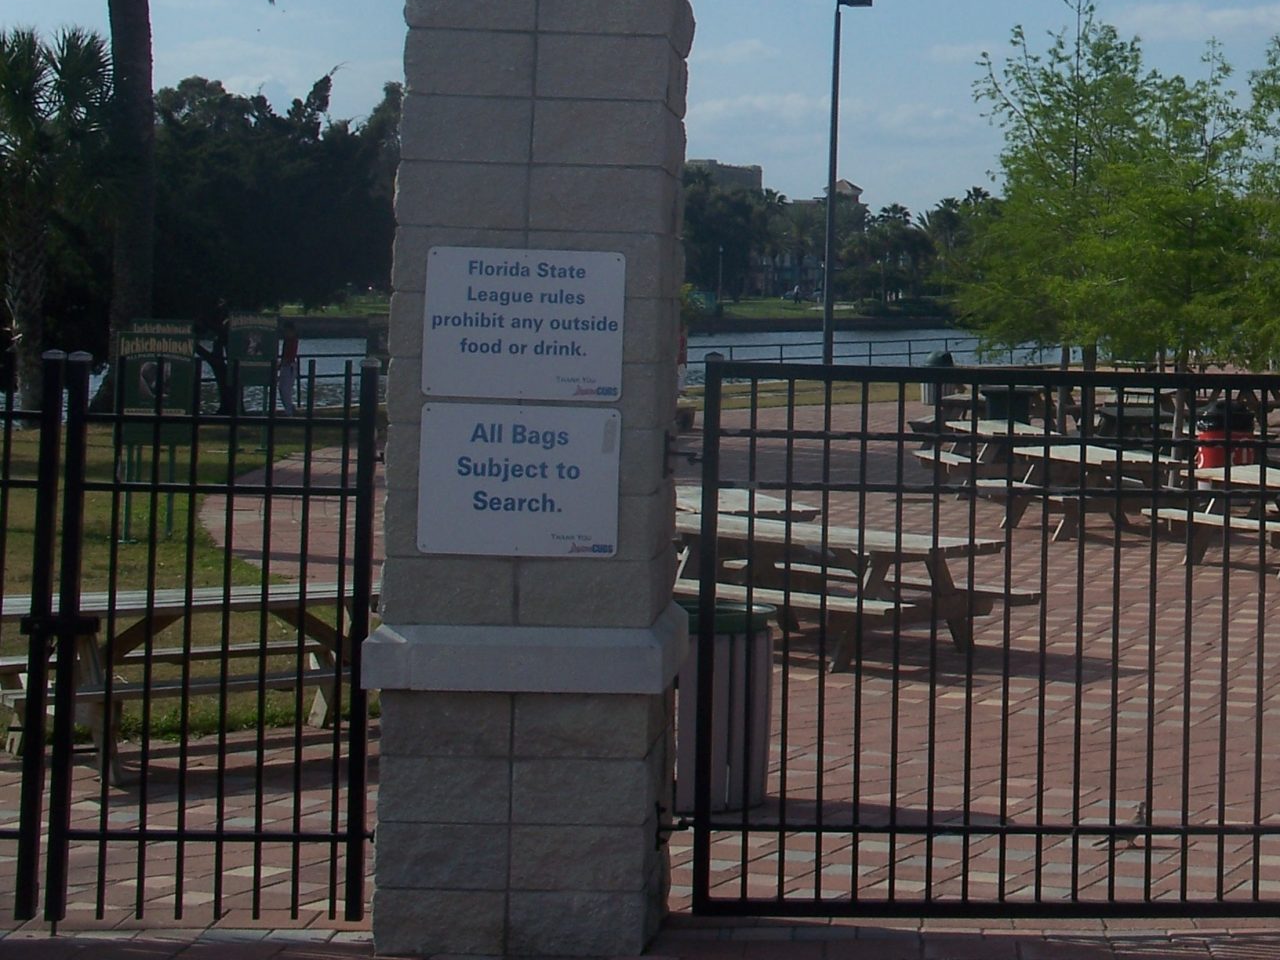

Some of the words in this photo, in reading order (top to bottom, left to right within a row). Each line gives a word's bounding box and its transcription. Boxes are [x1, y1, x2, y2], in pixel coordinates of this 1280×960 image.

[468, 260, 530, 277] Florida
[537, 262, 586, 279] State
[467, 286, 533, 306] League
[540, 289, 585, 305] rules
[432, 313, 504, 330] prohibit
[511, 318, 544, 333] any
[550, 316, 618, 332] outside
[460, 338, 502, 354] food
[508, 343, 527, 355] or
[534, 340, 587, 357] drink.
[470, 423, 503, 444] All
[512, 424, 569, 450] Bags
[457, 456, 548, 482] Subject
[556, 462, 580, 480] to
[472, 491, 562, 513] Search.
